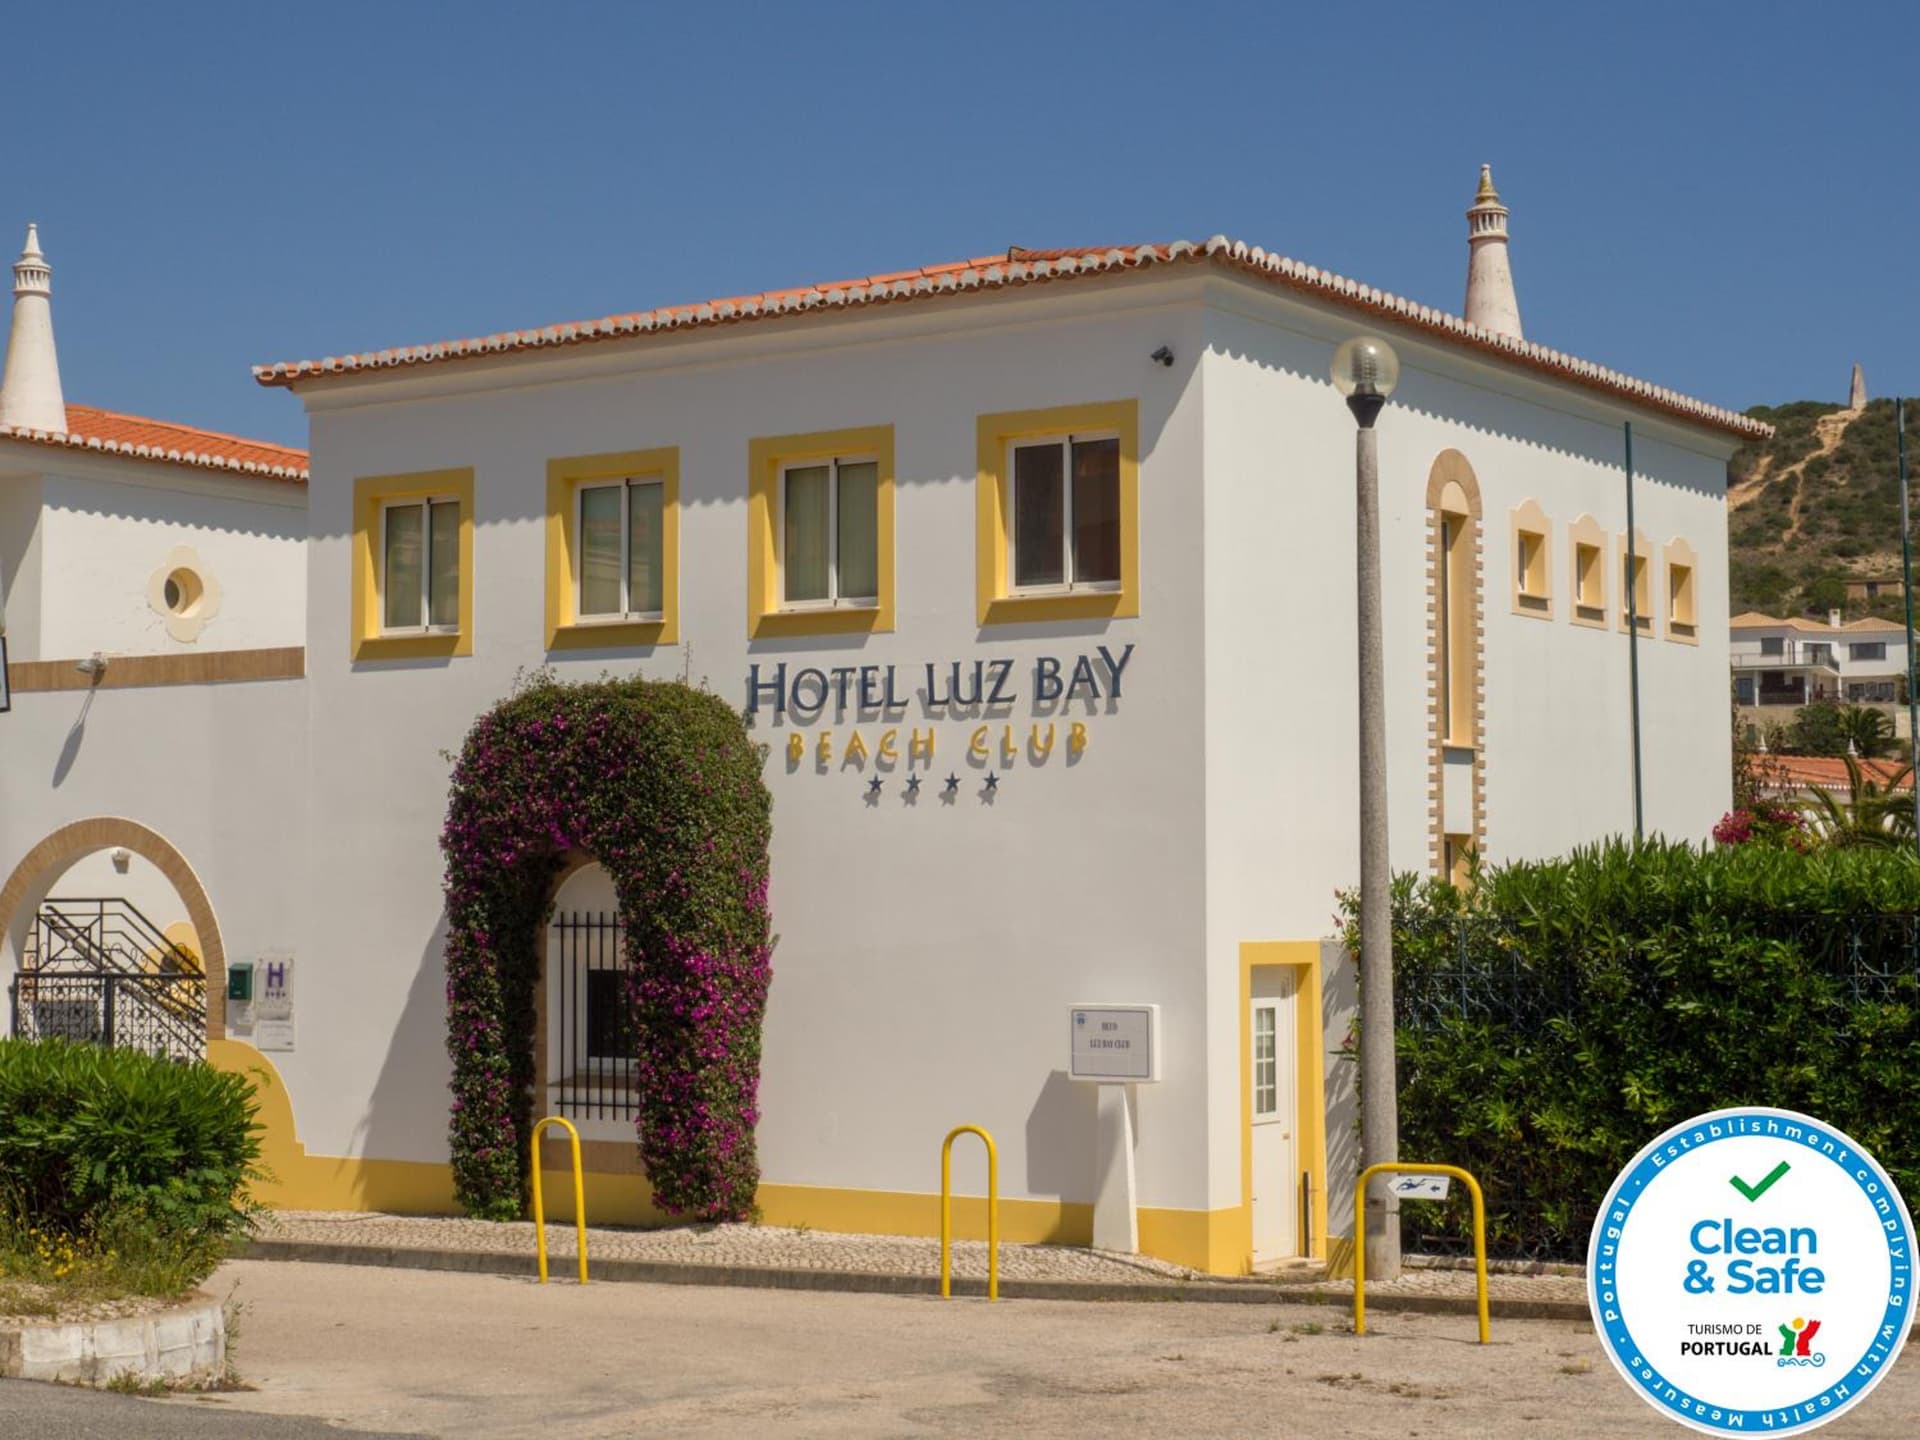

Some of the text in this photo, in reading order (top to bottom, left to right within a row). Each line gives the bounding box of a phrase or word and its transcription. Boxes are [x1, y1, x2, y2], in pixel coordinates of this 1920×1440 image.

[749, 643, 1136, 714] HOTEL LUZ BAY
[789, 722, 1088, 762] BEACH CLUB
[268, 962, 283, 988] H
